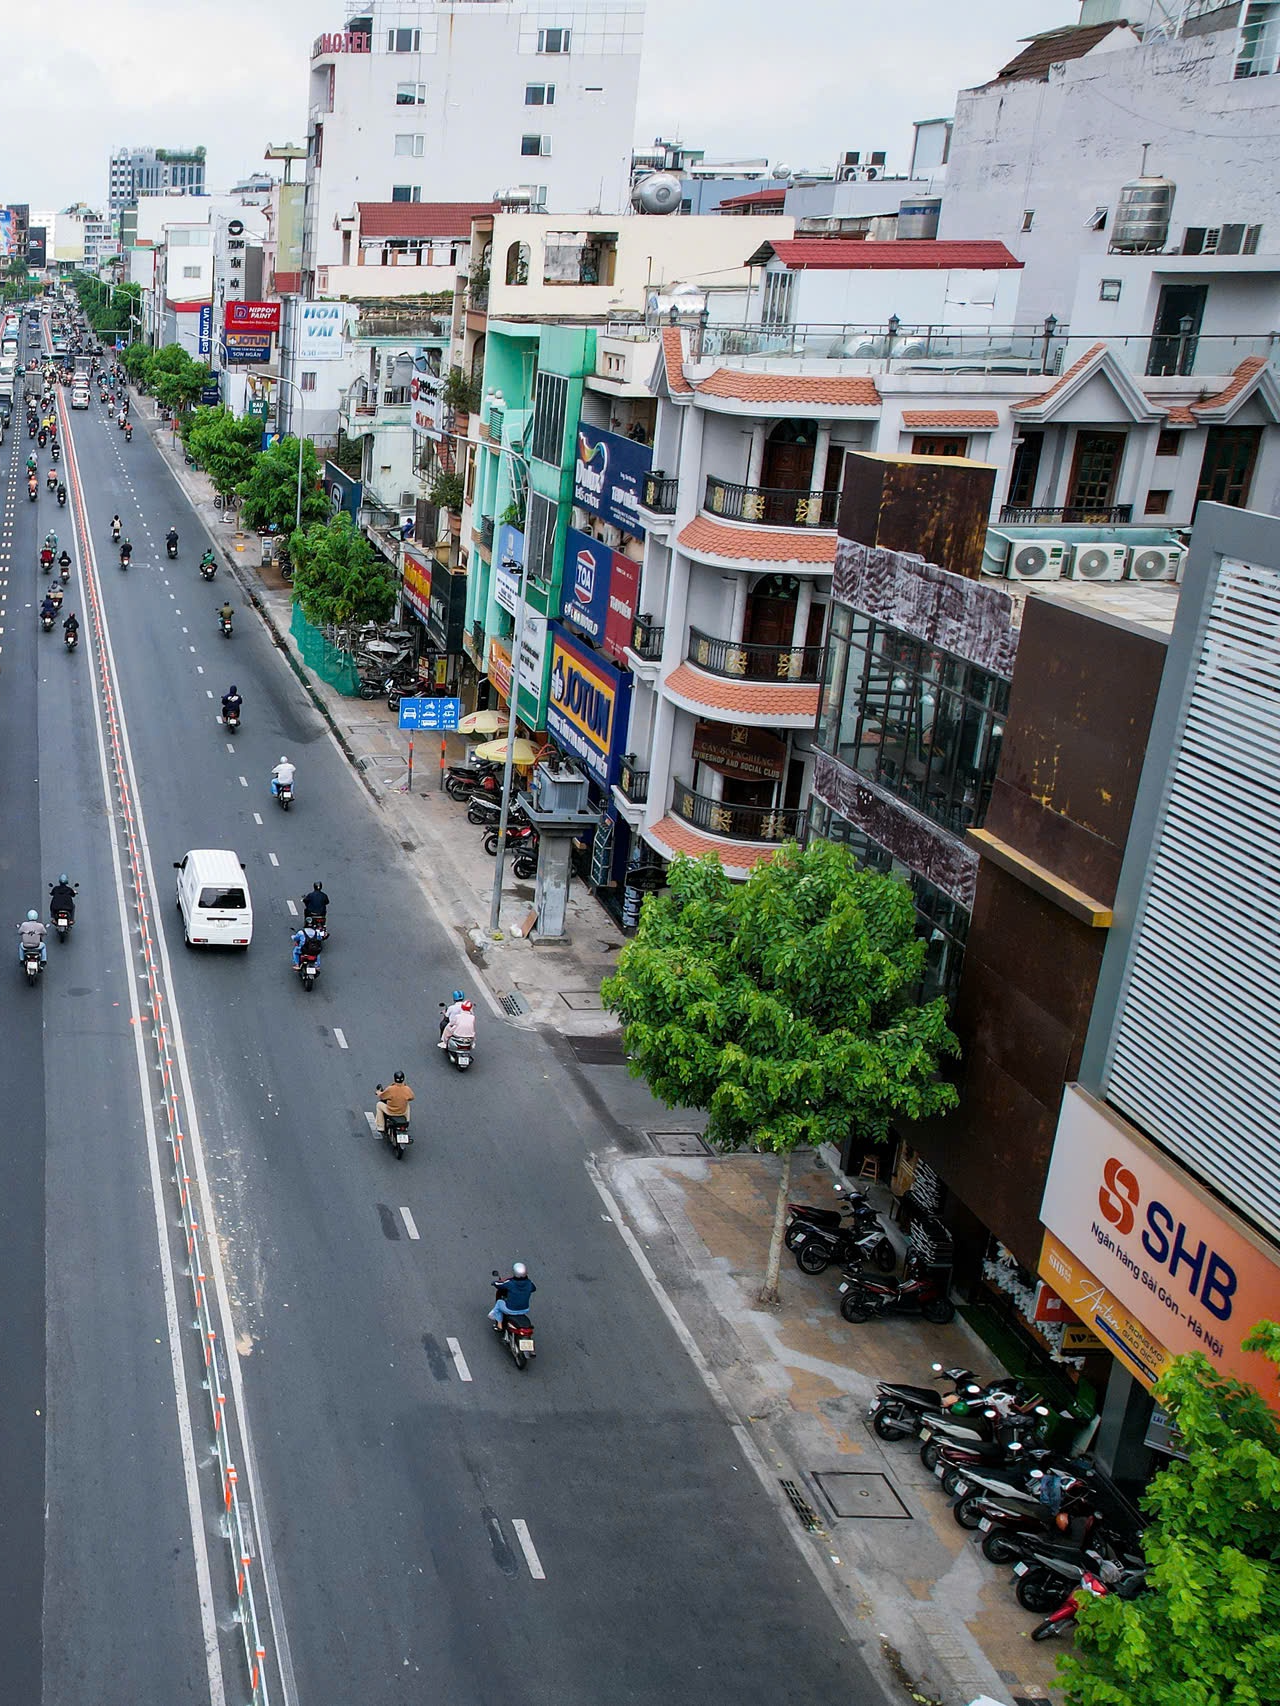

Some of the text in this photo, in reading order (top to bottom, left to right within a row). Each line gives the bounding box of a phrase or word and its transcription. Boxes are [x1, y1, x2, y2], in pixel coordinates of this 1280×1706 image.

[321, 32, 370, 53] HOTEL
[303, 307, 339, 319] HOA
[237, 335, 269, 345] JOTUN
[575, 458, 604, 494] Dulux
[577, 563, 591, 590] TOA
[563, 665, 611, 743] JOTUN
[726, 758, 739, 768] AND
[741, 761, 762, 775] SOCIAL
[763, 768, 780, 779] CLUB
[1141, 1200, 1237, 1321] SHB
[1090, 1221, 1115, 1253] Ngân
[1115, 1245, 1140, 1280] hàng
[1141, 1270, 1158, 1294] Sài
[1158, 1287, 1179, 1317] Gòn
[1187, 1314, 1203, 1340] Hà
[1204, 1331, 1225, 1358] Nội
[1121, 1329, 1157, 1368] GIAO DỊCH
[1124, 1319, 1151, 1349] TRONG
